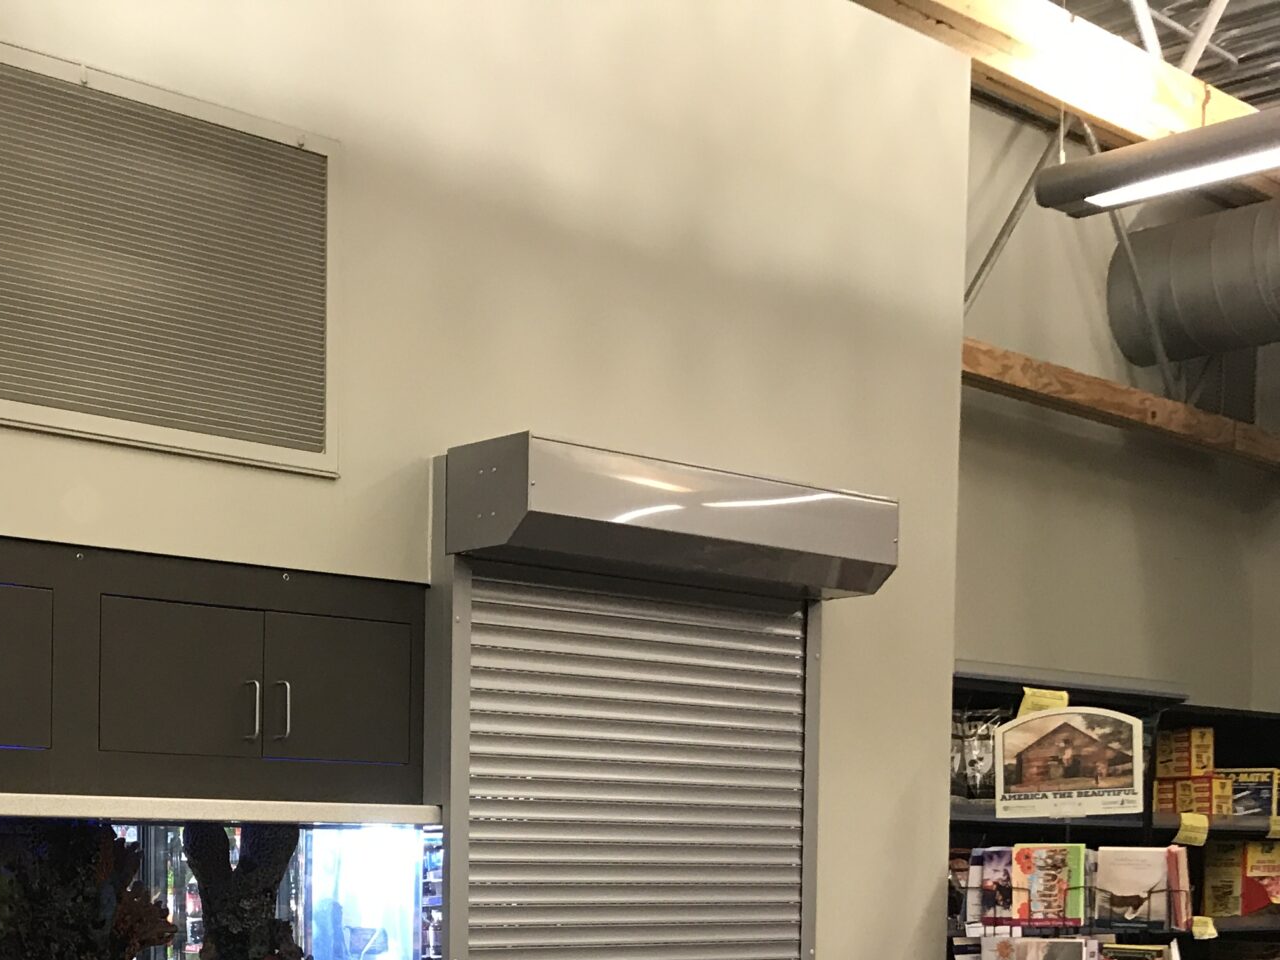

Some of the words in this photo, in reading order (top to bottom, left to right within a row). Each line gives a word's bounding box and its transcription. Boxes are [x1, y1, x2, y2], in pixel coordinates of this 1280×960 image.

[1000, 792, 1048, 802] AMERICA
[1052, 790, 1073, 799] THE
[1076, 789, 1138, 798] BEAUTIFUL
